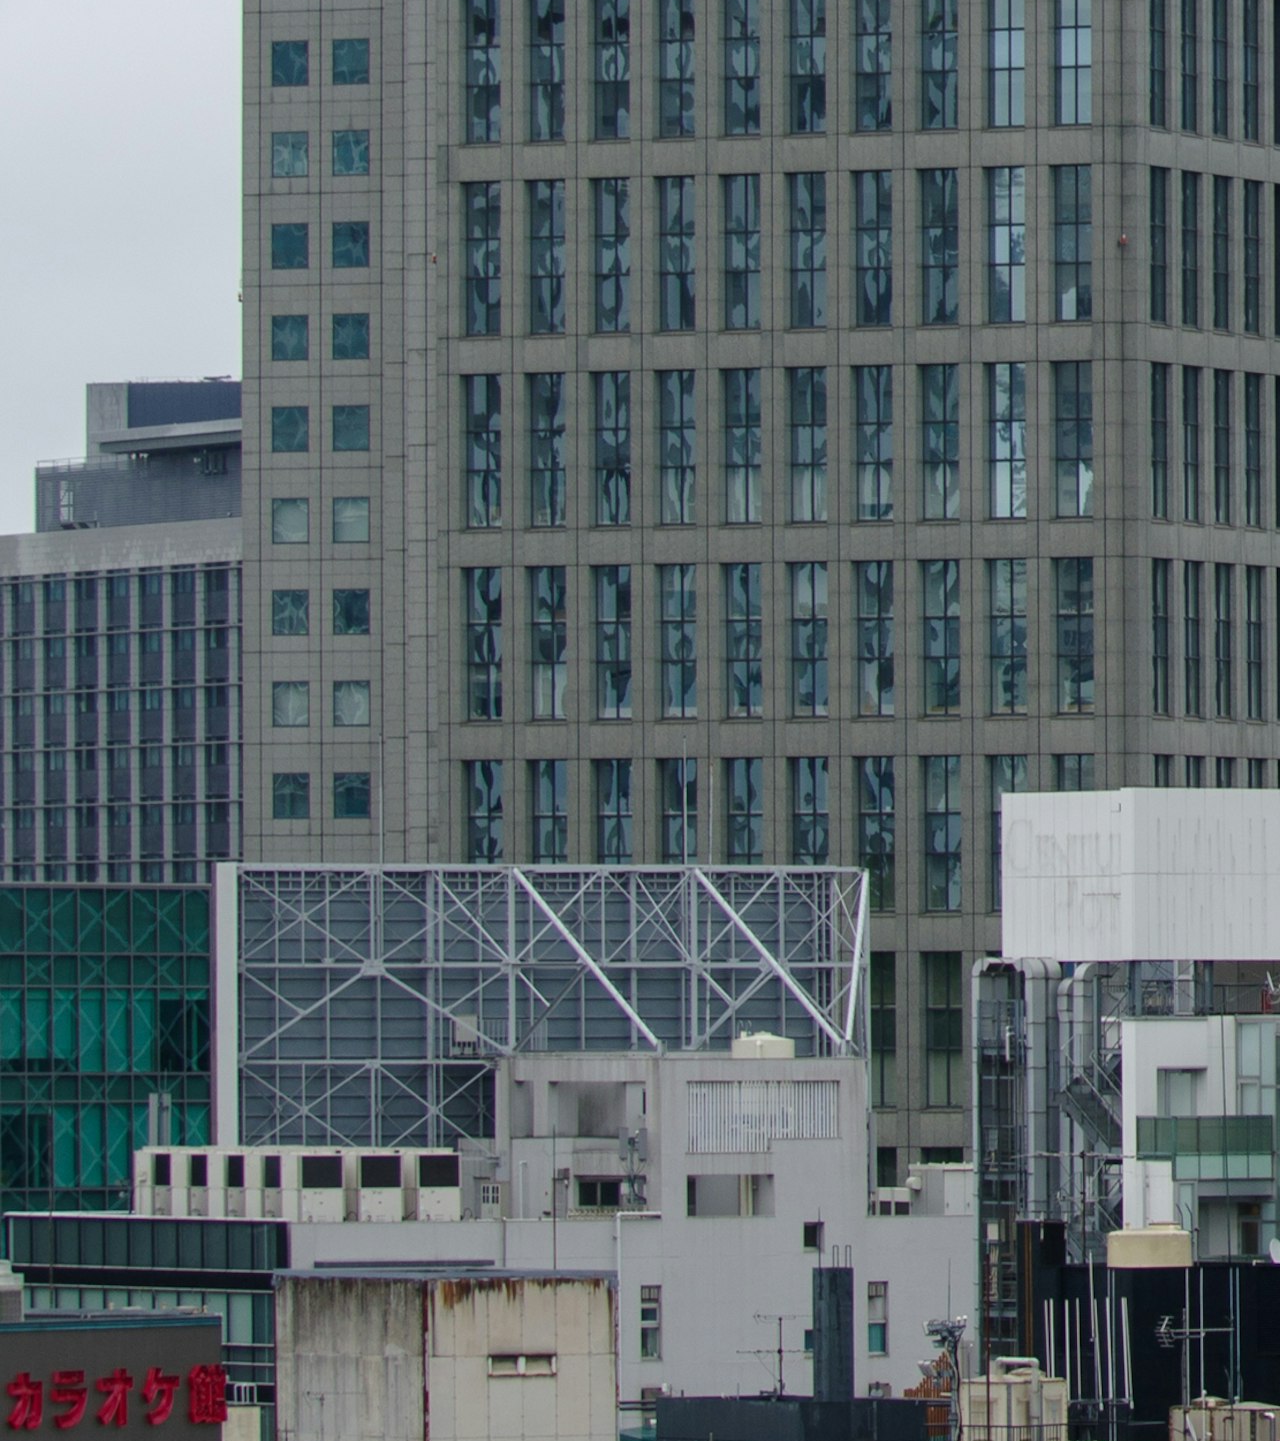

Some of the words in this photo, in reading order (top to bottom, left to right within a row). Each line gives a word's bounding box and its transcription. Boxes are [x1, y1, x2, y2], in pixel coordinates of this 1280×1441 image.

[6, 1364, 228, 1430] カラオケ館
